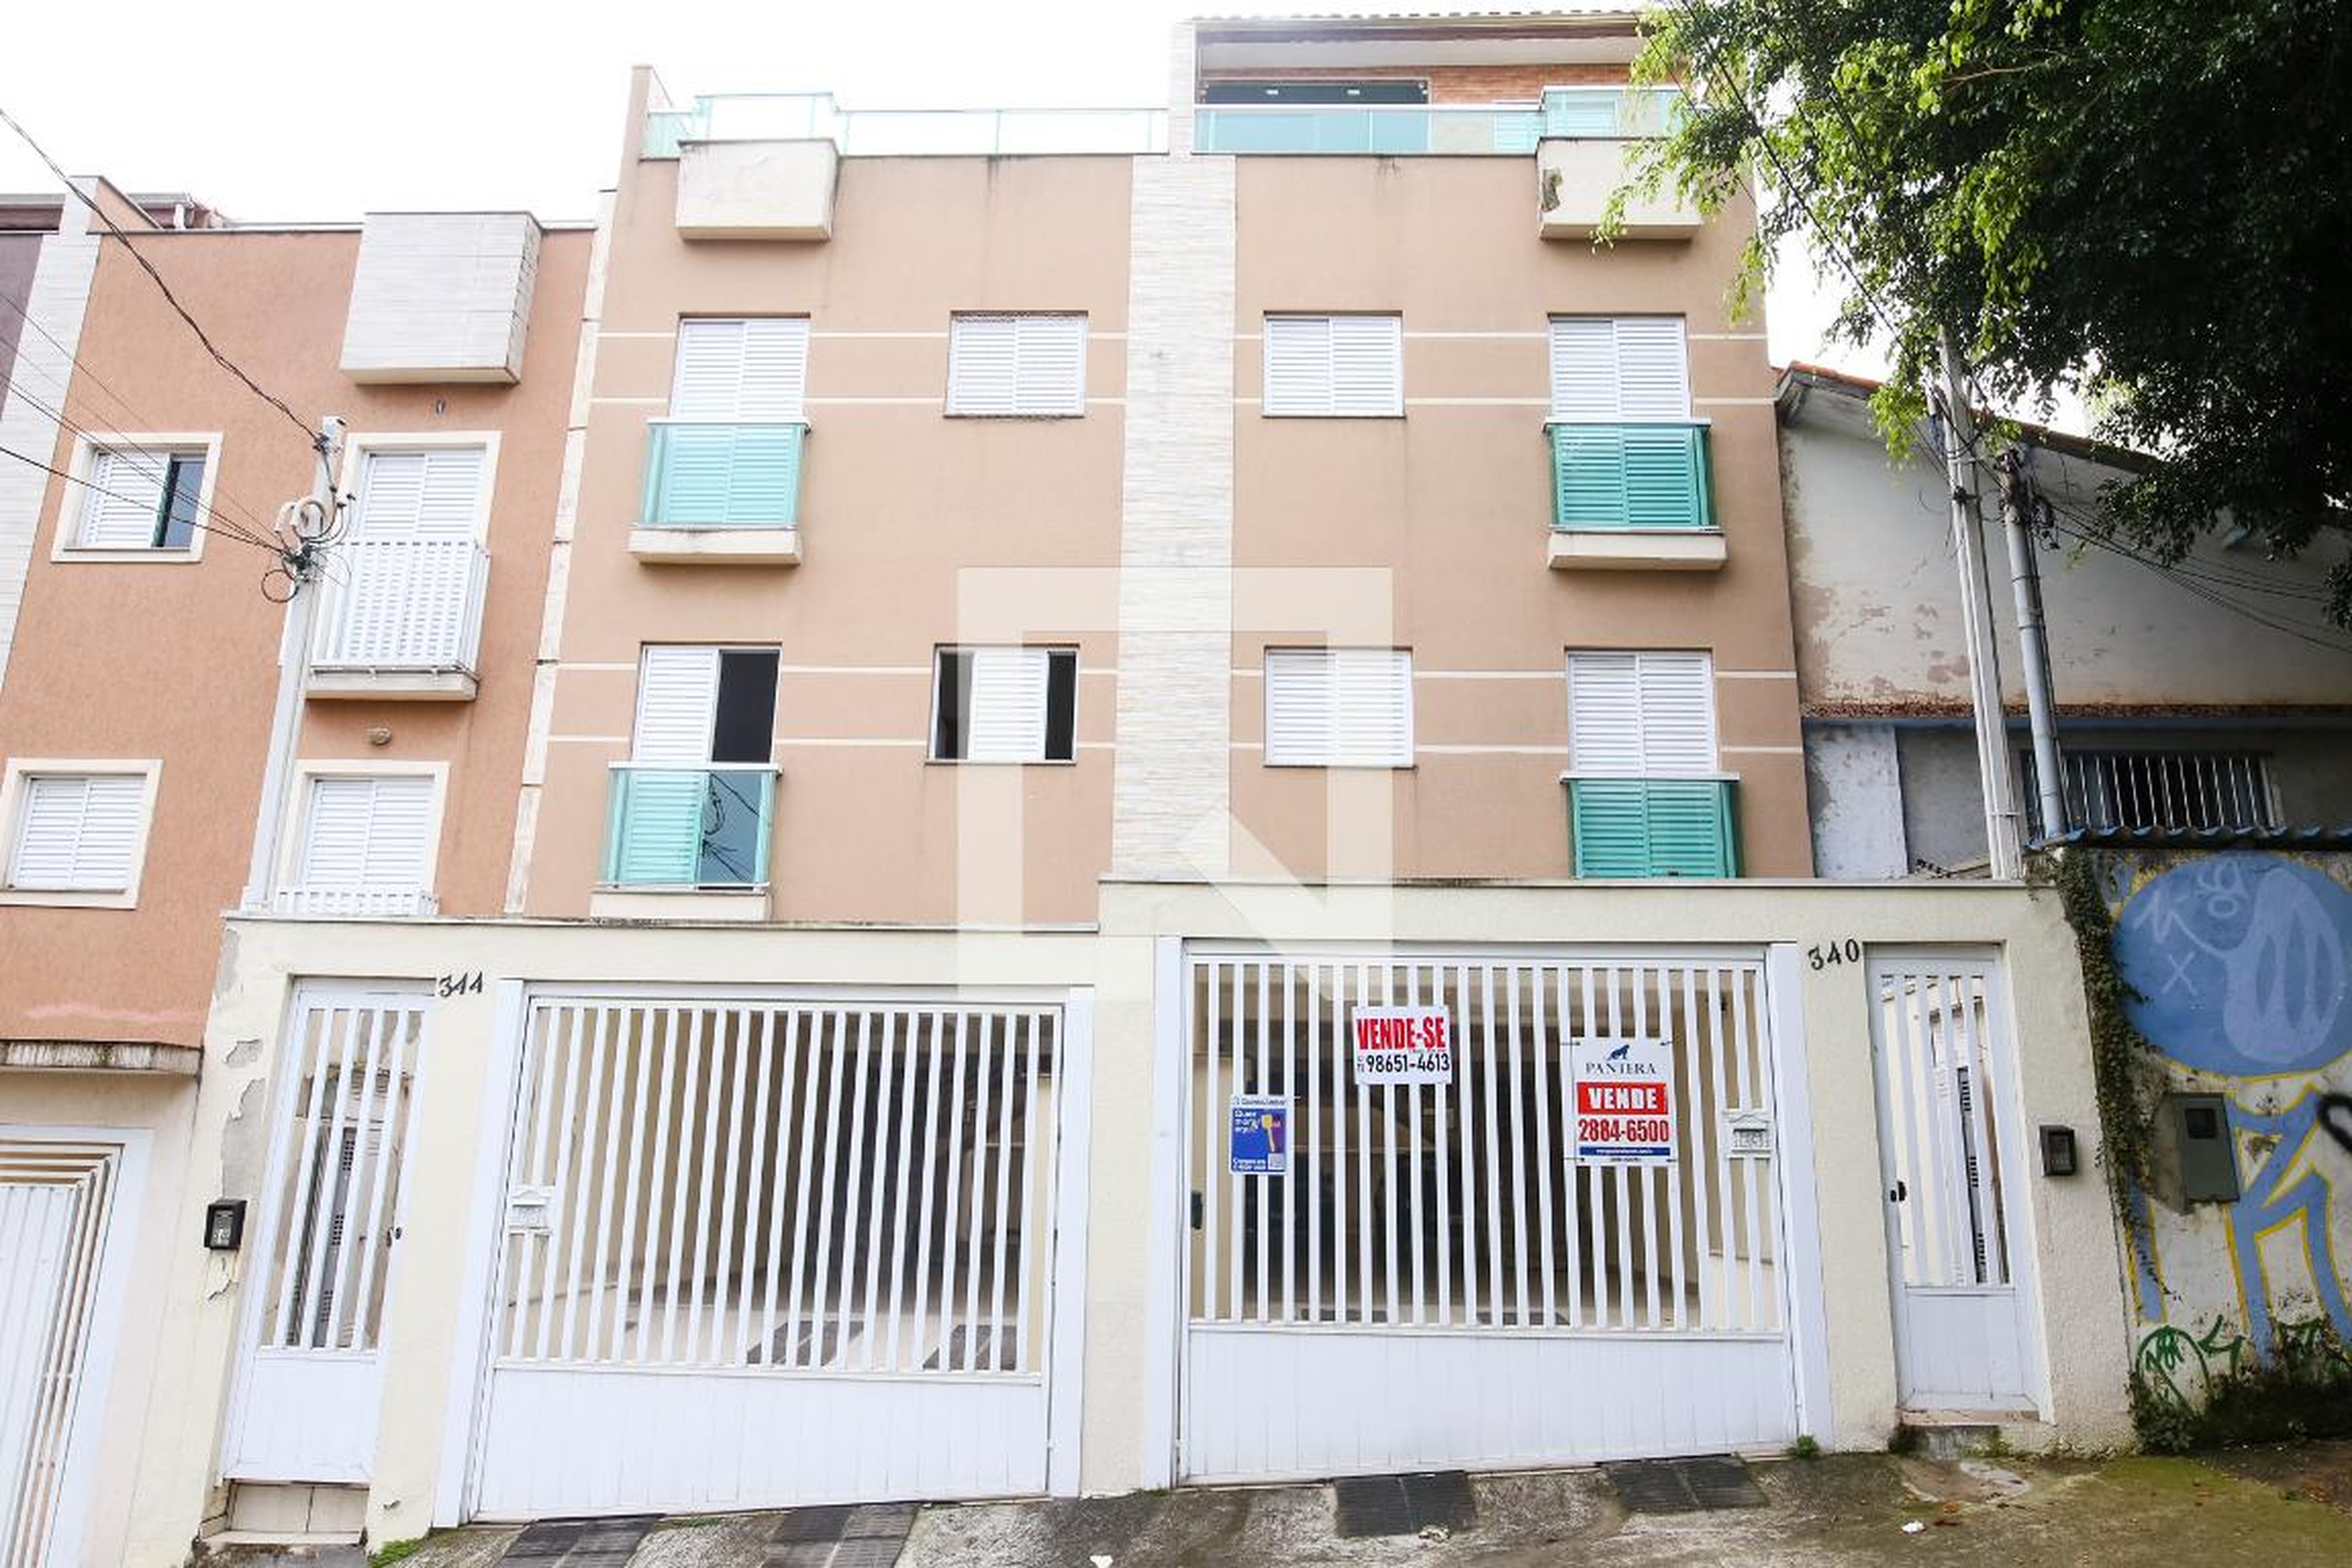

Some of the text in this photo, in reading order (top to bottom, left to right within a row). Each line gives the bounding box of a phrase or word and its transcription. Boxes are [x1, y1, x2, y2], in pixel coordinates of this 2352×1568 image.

[1807, 938, 1860, 971] 340
[439, 971, 482, 998] 344
[1356, 1016, 1446, 1049] VENDE-SE
[1366, 1053, 1450, 1072] 98651-4613
[1585, 1063, 1657, 1074] PANTERA
[1588, 1088, 1658, 1110] VENDE
[1578, 1118, 1669, 1142] 2884-6500
